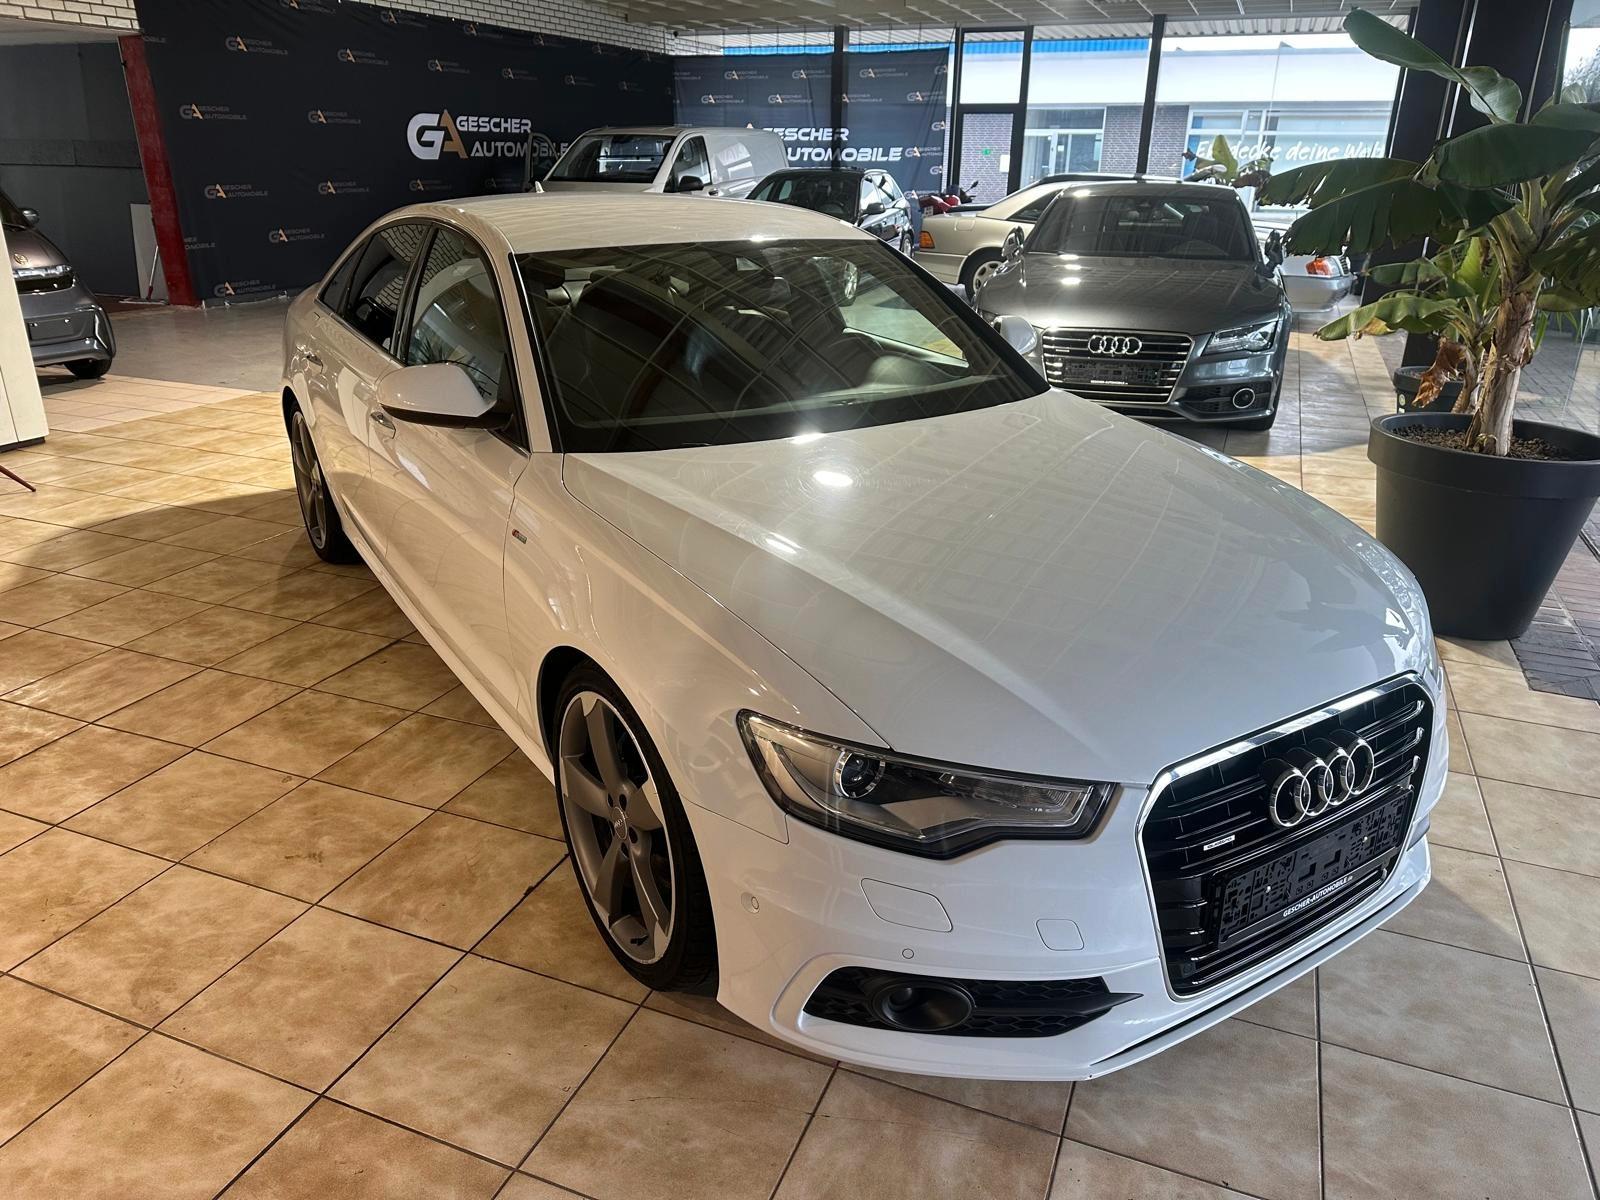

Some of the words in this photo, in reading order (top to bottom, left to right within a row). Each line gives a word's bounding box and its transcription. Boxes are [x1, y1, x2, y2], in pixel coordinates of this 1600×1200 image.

[456, 115, 532, 133] GESCHER
[407, 108, 469, 160] GA
[762, 127, 850, 141] ESCHER
[787, 147, 903, 161] UTOMOBILE
[1195, 140, 1282, 160] Edecke
[1285, 141, 1337, 160] deine
